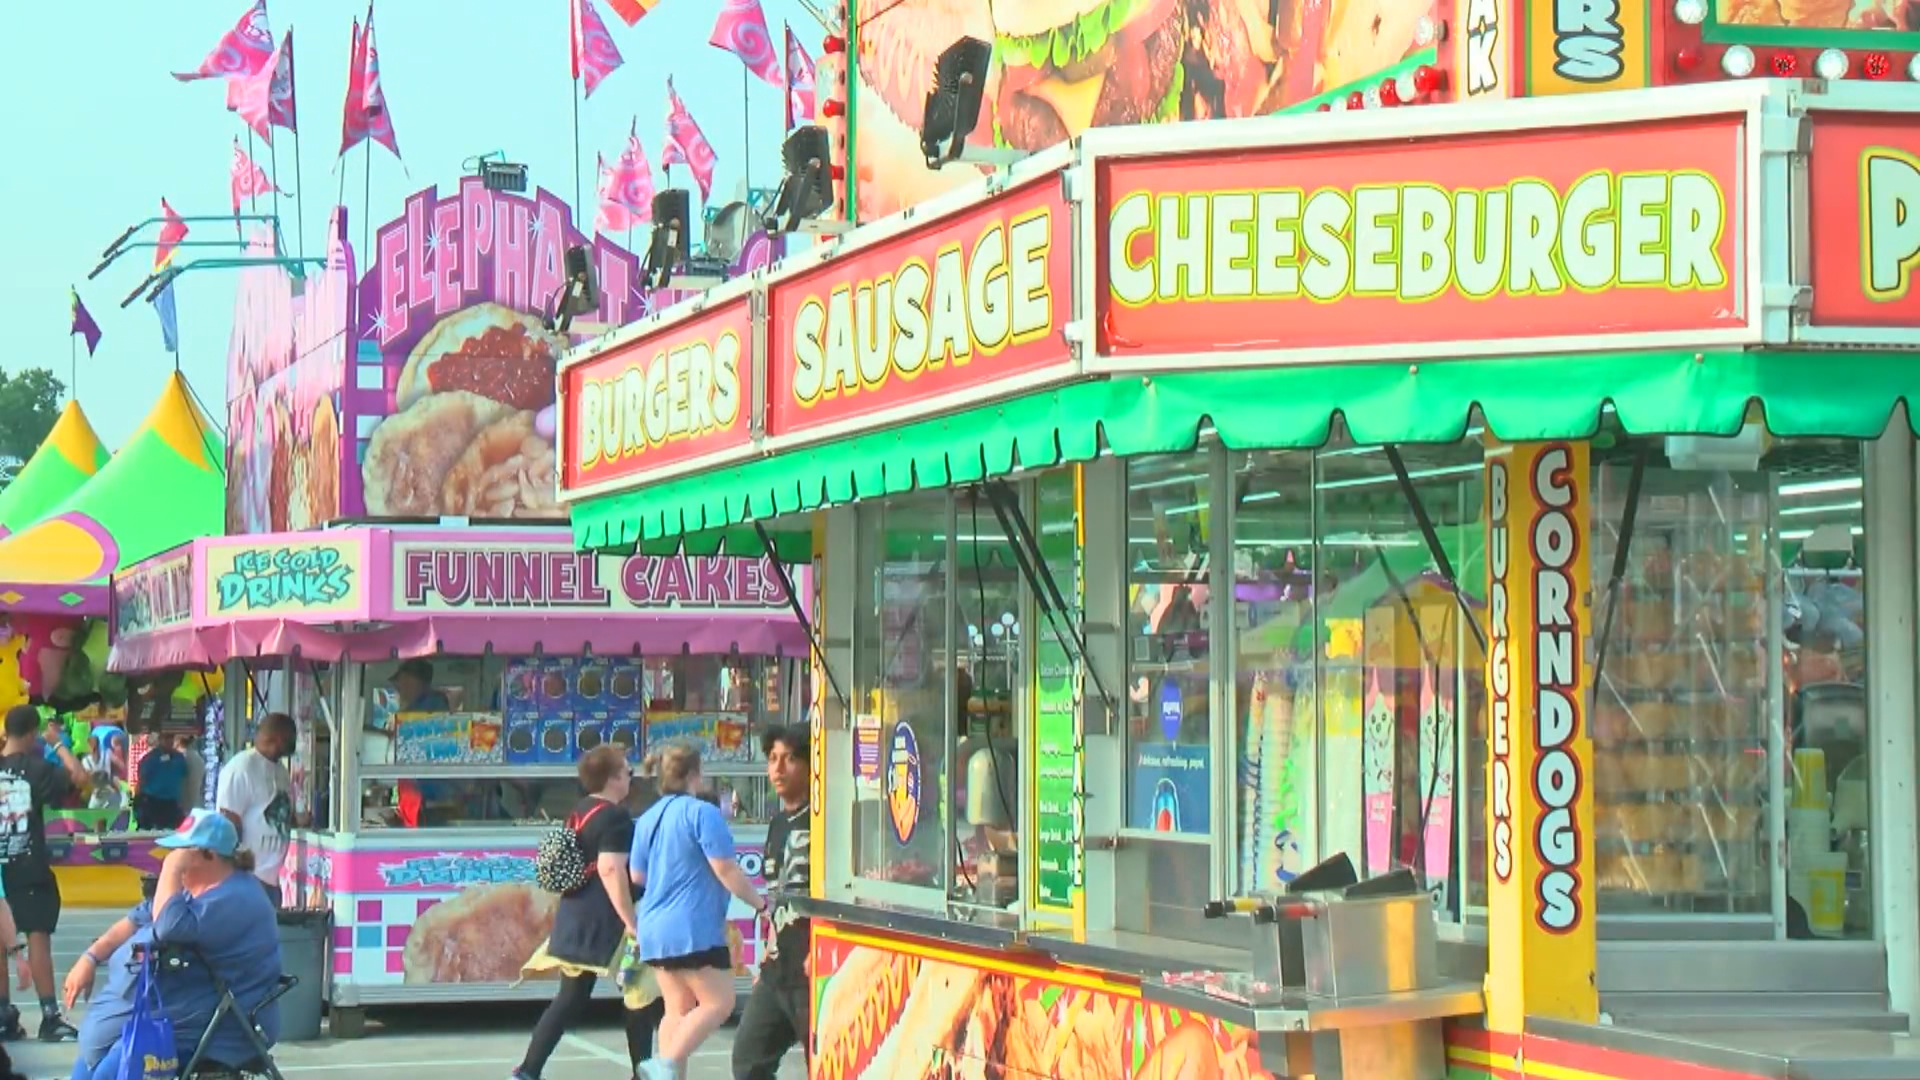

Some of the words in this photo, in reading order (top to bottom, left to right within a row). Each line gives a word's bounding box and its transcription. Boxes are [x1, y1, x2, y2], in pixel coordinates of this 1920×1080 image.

[379, 180, 629, 346] ELEPHAT
[793, 207, 1053, 409] SAUSAGE
[1108, 168, 1727, 306] CHEESEBURGER
[582, 328, 741, 470] BURGERS
[217, 564, 354, 610] DRINKS
[234, 550, 270, 573] ICE
[273, 547, 339, 573] COLD
[405, 550, 610, 606] FUNNEL
[620, 552, 792, 607] CAKES
[1489, 461, 1515, 886] BURGERS
[1528, 441, 1582, 937] CORNDOGS
